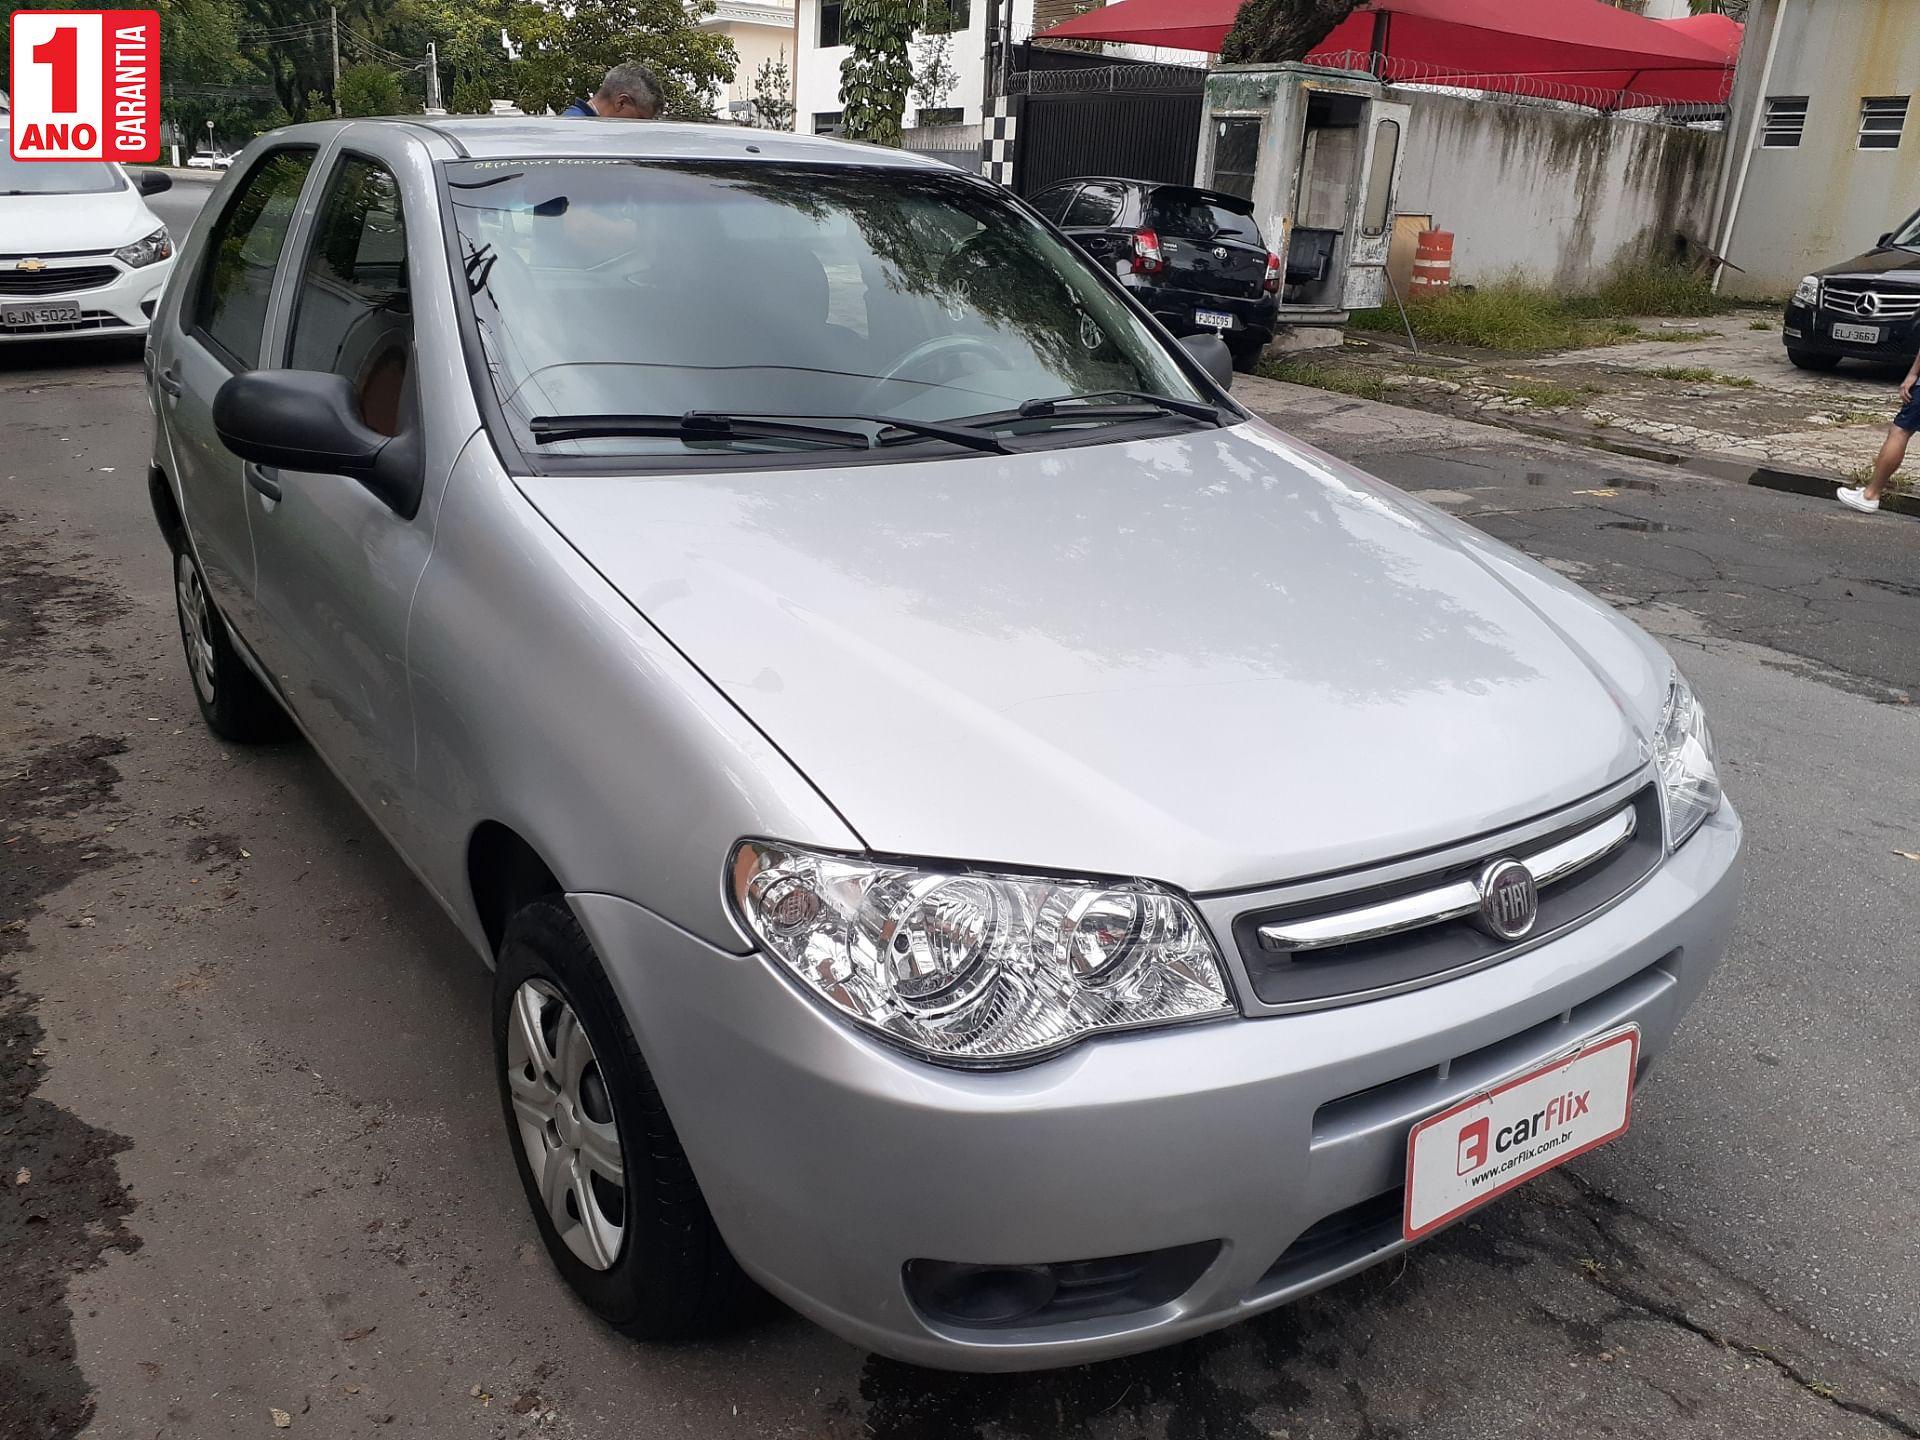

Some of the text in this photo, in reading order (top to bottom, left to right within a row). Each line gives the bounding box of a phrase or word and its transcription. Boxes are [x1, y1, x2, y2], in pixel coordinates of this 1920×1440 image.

[1499, 881, 1528, 922] FIAT
[1495, 1090, 1590, 1153] carflix
[1471, 1130, 1573, 1187] www.carflix.com.br
